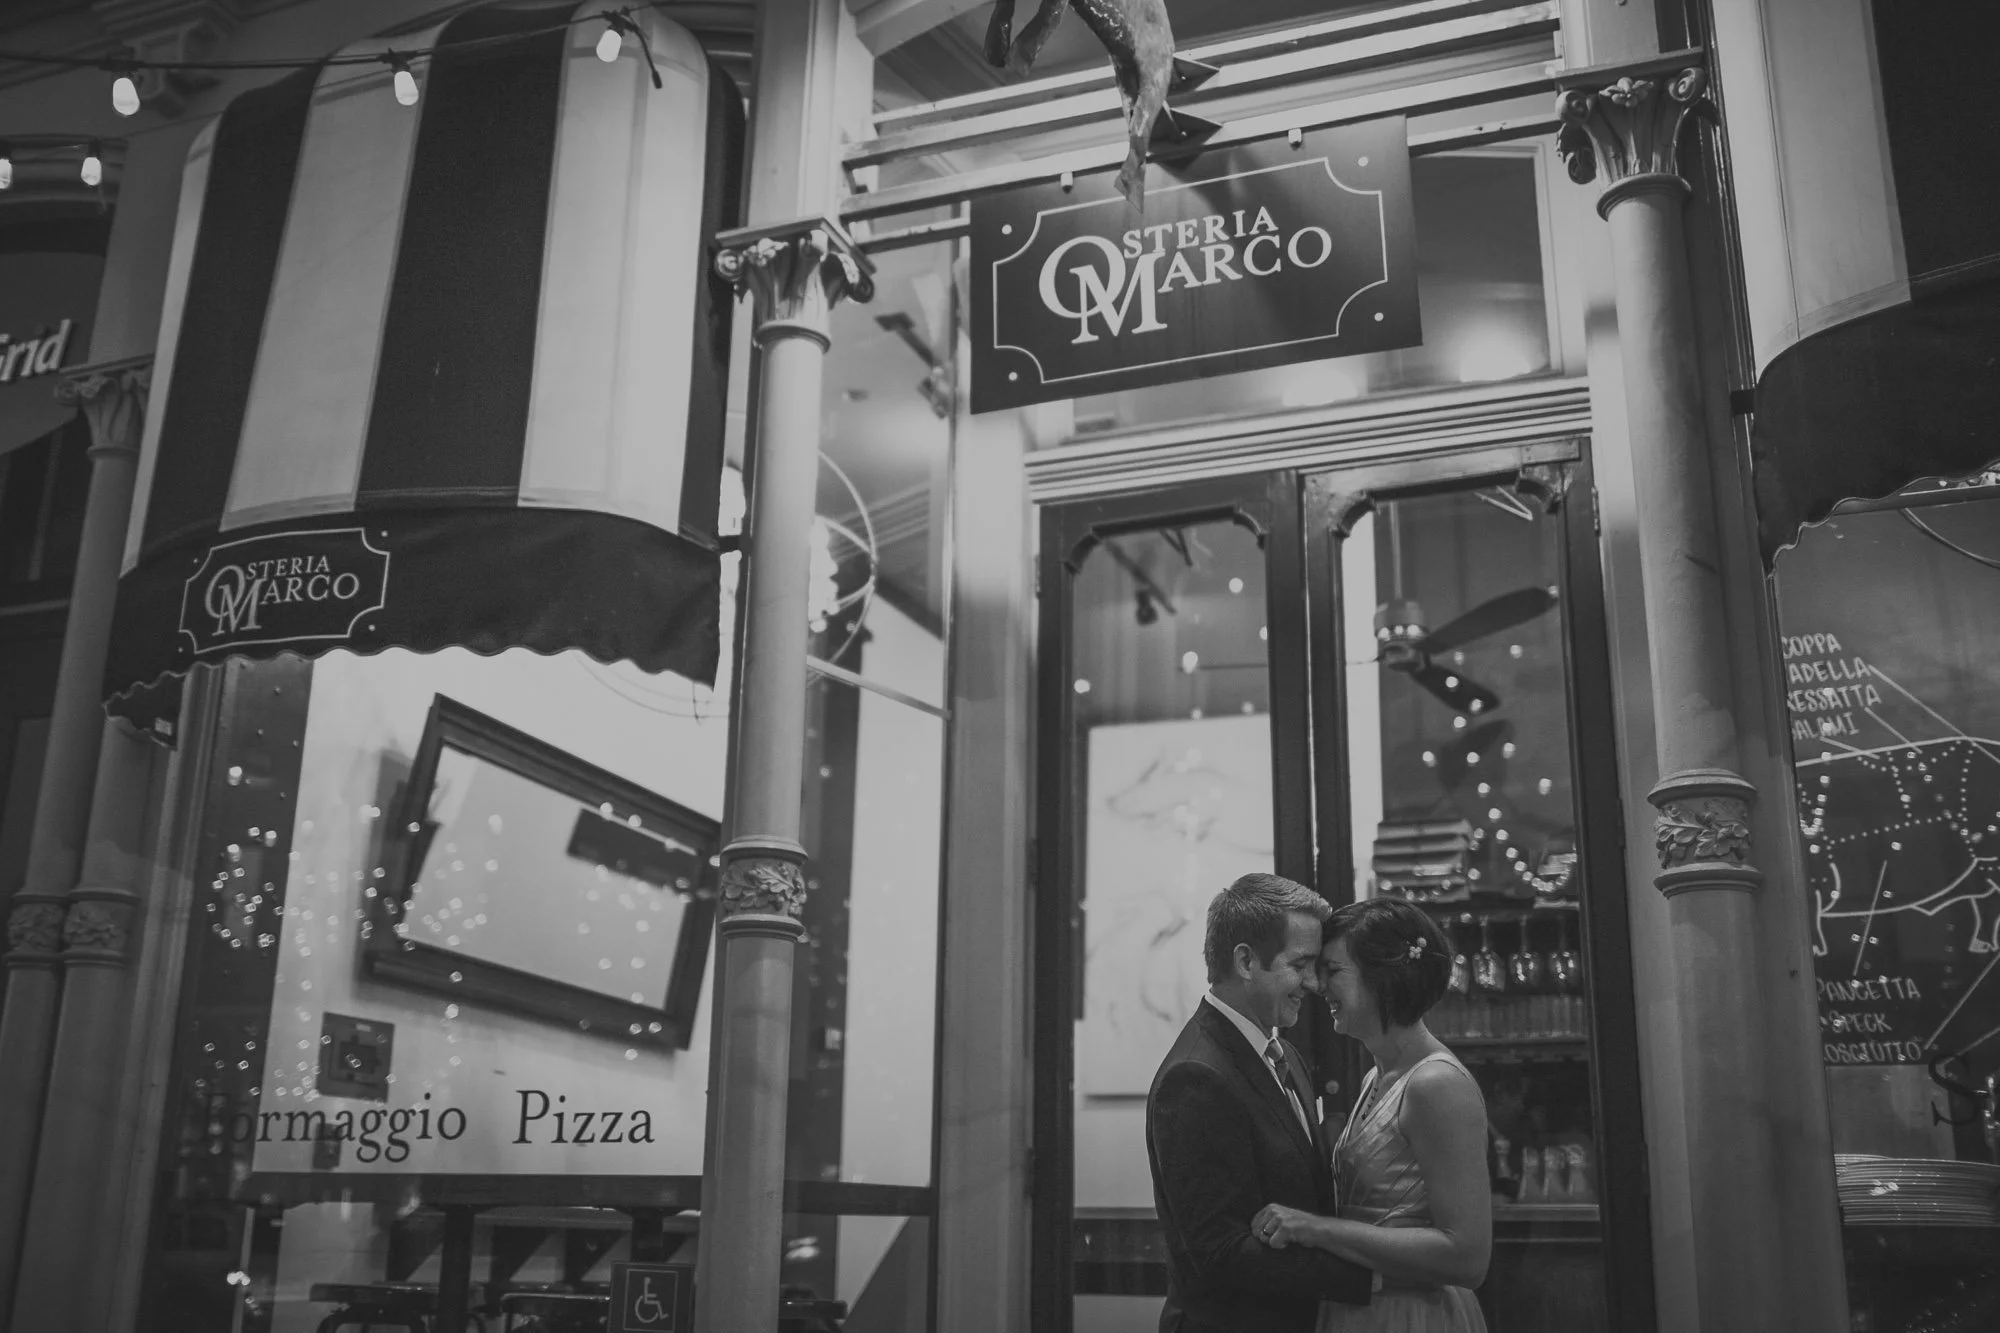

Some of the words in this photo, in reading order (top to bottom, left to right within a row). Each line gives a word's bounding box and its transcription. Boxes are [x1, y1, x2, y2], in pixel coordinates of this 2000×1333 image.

[1039, 206, 1279, 319] OSTERIA
[1069, 226, 1333, 345] MARCO
[0, 318, 71, 381] rid
[205, 555, 331, 618] OSTERIA
[212, 573, 360, 636] MARCO
[1781, 632, 1842, 659] COPPA
[512, 1089, 656, 1145] Pizza
